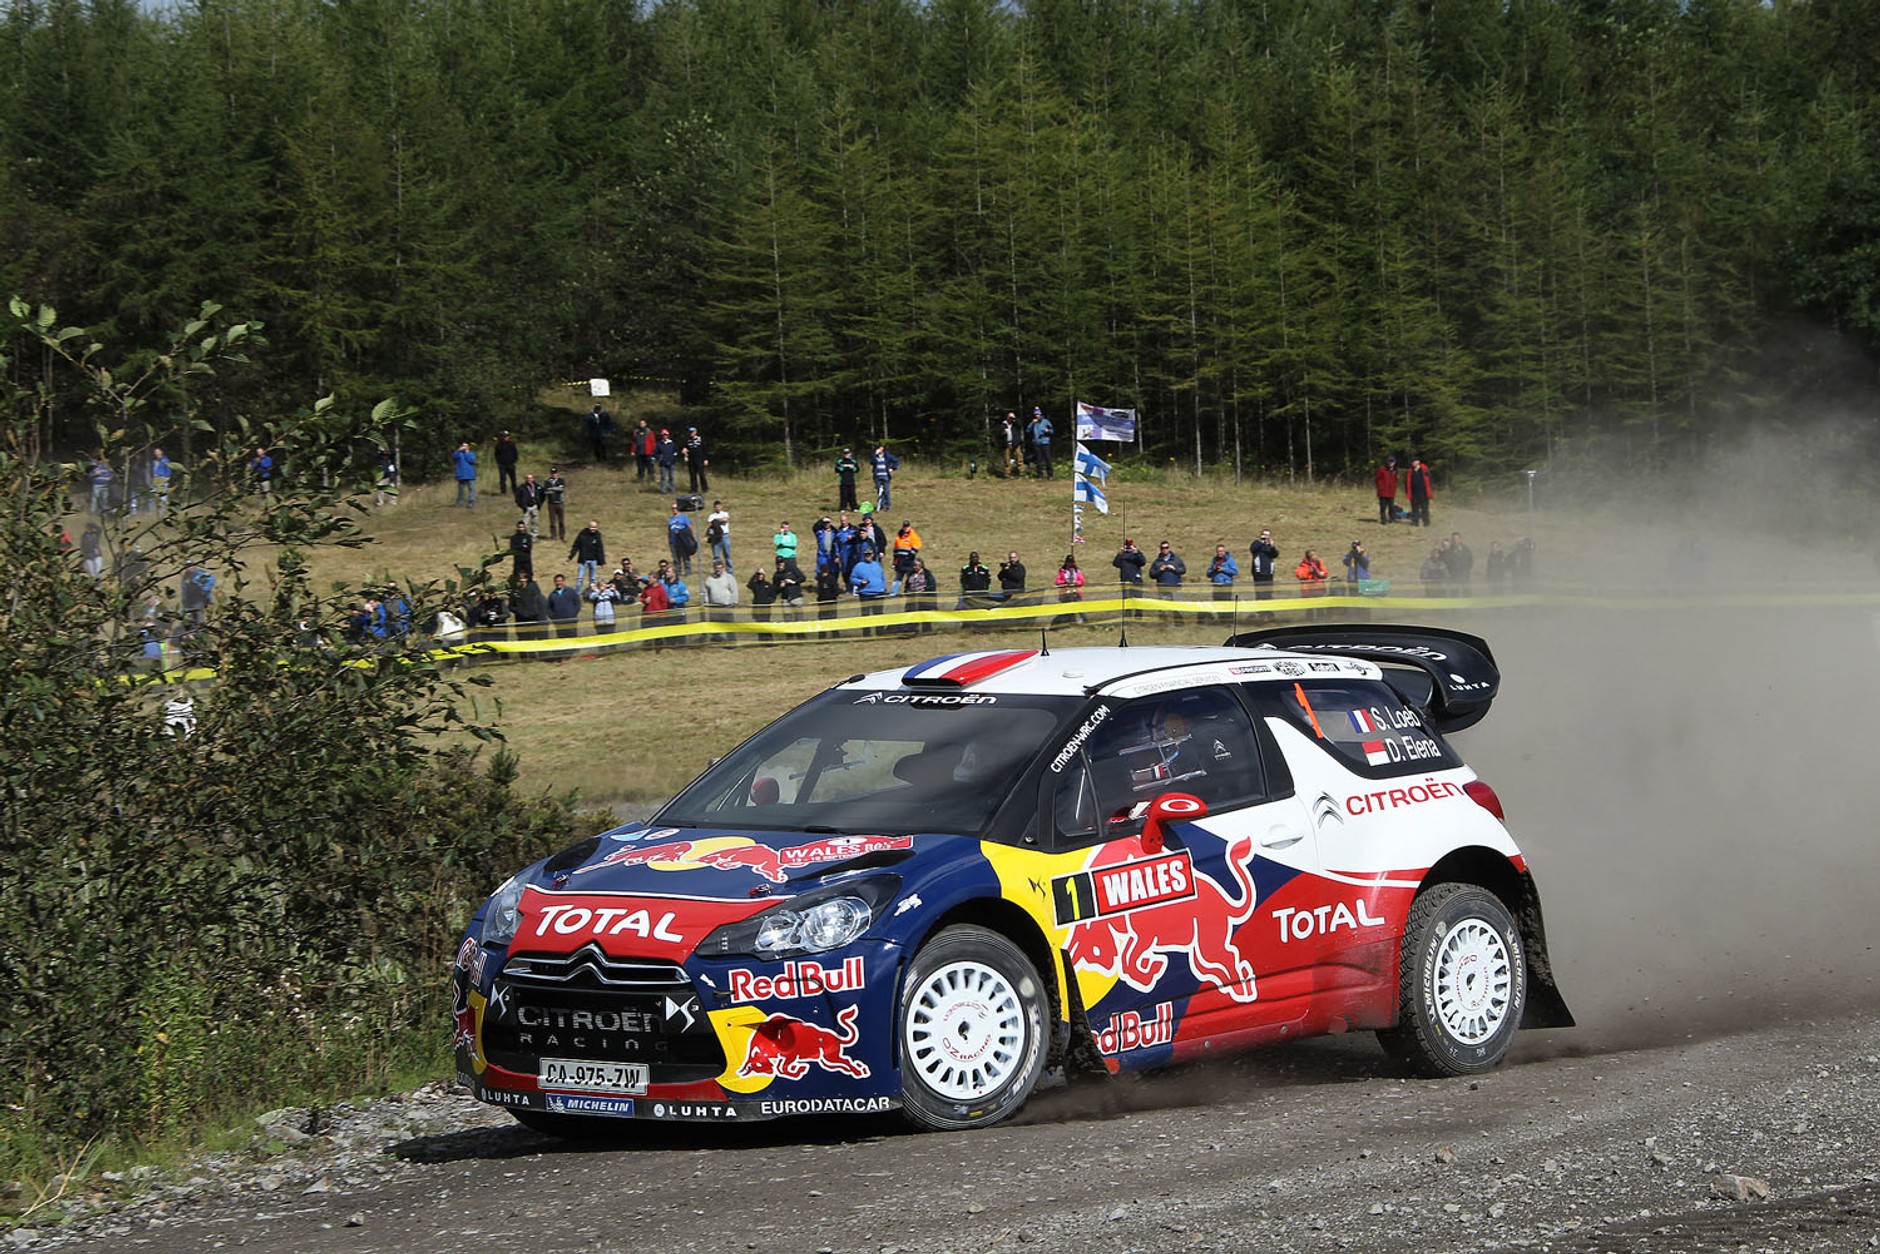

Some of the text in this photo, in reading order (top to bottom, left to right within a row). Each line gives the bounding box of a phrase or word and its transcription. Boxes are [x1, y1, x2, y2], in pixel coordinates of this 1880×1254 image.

[1370, 705, 1421, 731] S. Loeb
[1384, 735, 1442, 763] D. Elena
[784, 843, 861, 859] WALES
[1065, 859, 1187, 921] 1 WALES
[535, 904, 684, 944] TOTAL
[1272, 898, 1386, 944] TOTAL
[730, 962, 797, 1002] Red
[800, 957, 864, 997] Bull
[1121, 1002, 1172, 1051] Bull
[545, 1063, 641, 1089] CA-975-ZW
[487, 1089, 530, 1106] LUHTA
[566, 1098, 630, 1113] MICHELIN
[760, 1096, 890, 1115] EURODATACAR
[668, 1105, 737, 1118] LUHTA
